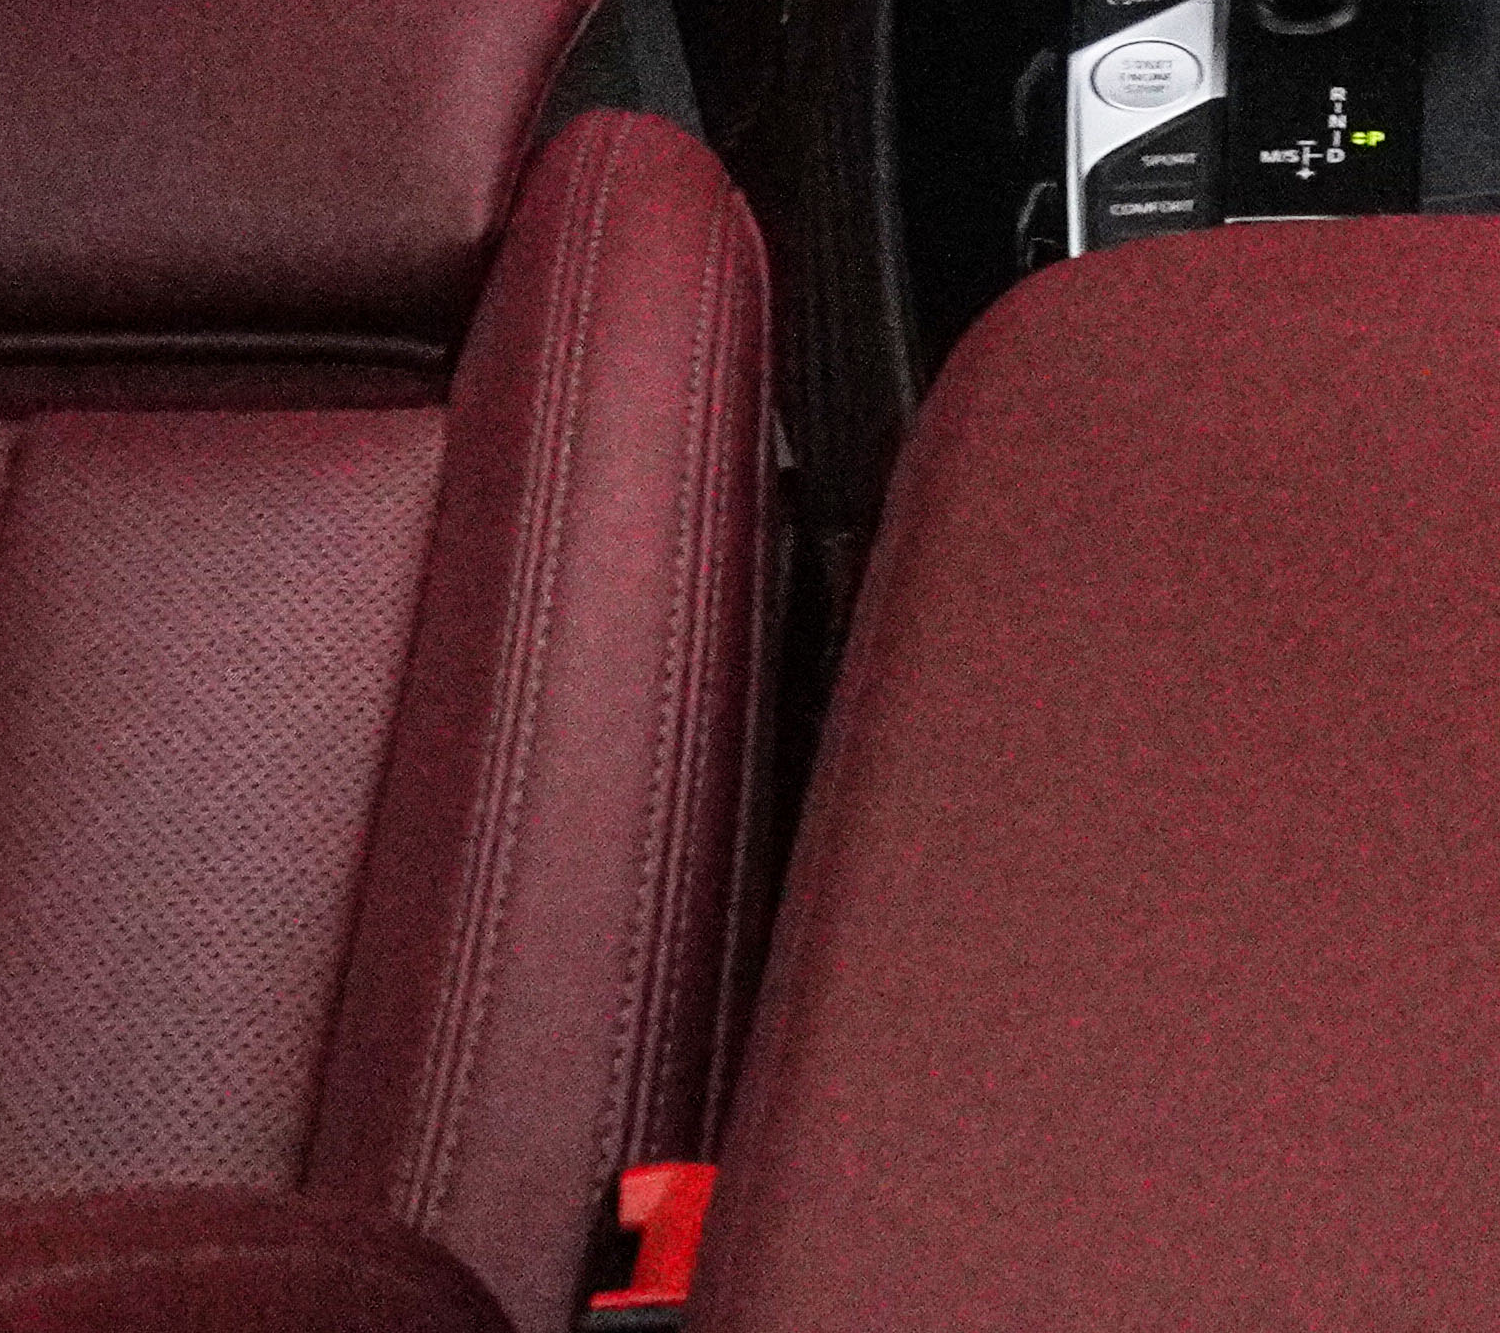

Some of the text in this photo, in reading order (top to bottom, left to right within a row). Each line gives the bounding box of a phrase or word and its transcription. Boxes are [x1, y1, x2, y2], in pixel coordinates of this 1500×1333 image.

[1327, 113, 1348, 129] N
[1141, 152, 1198, 167] SPORT
[1326, 147, 1346, 163] D
[1109, 199, 1194, 217] COMFORT
